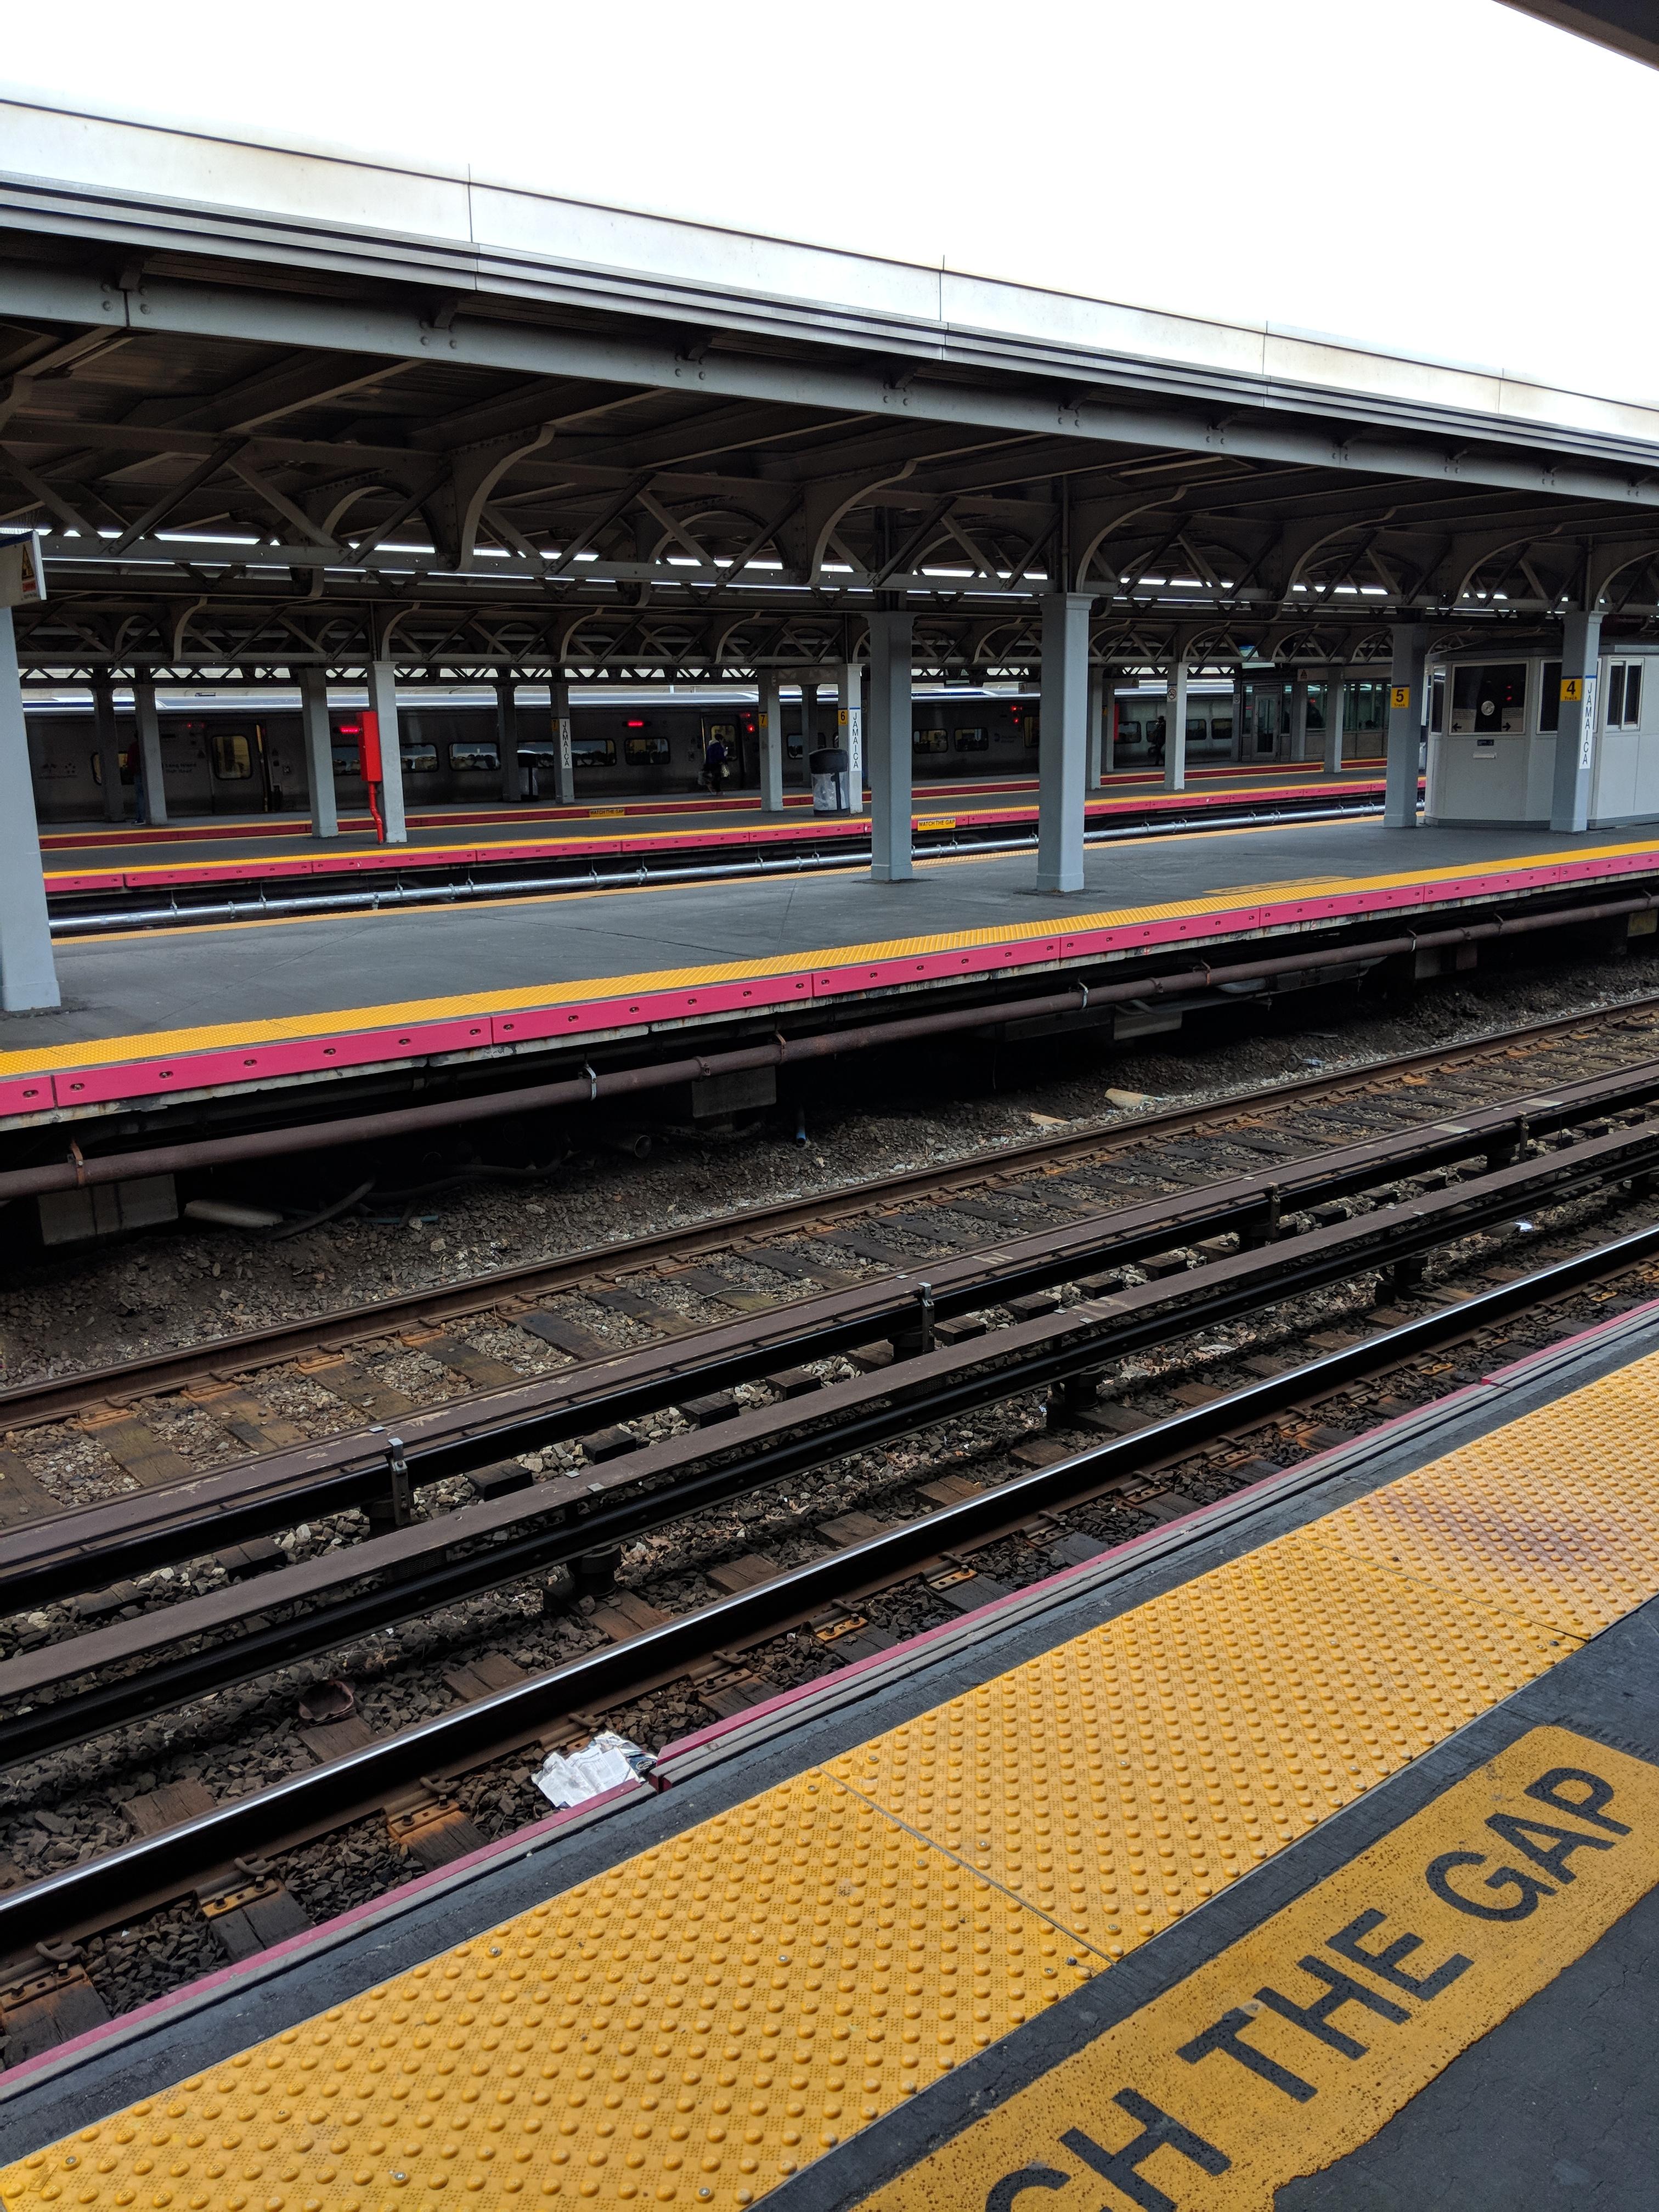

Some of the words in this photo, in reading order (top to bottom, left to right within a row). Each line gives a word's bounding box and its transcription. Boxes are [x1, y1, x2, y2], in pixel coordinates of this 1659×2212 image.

[1566, 681, 1576, 695] 4
[1396, 689, 1404, 703] 5
[760, 714, 765, 724] 7
[840, 711, 845, 721] 6
[552, 720, 556, 728] 7
[1583, 682, 1592, 765] JAMAICA
[1176, 1908, 1475, 2104] THE
[1426, 1767, 1632, 1922] GAP
